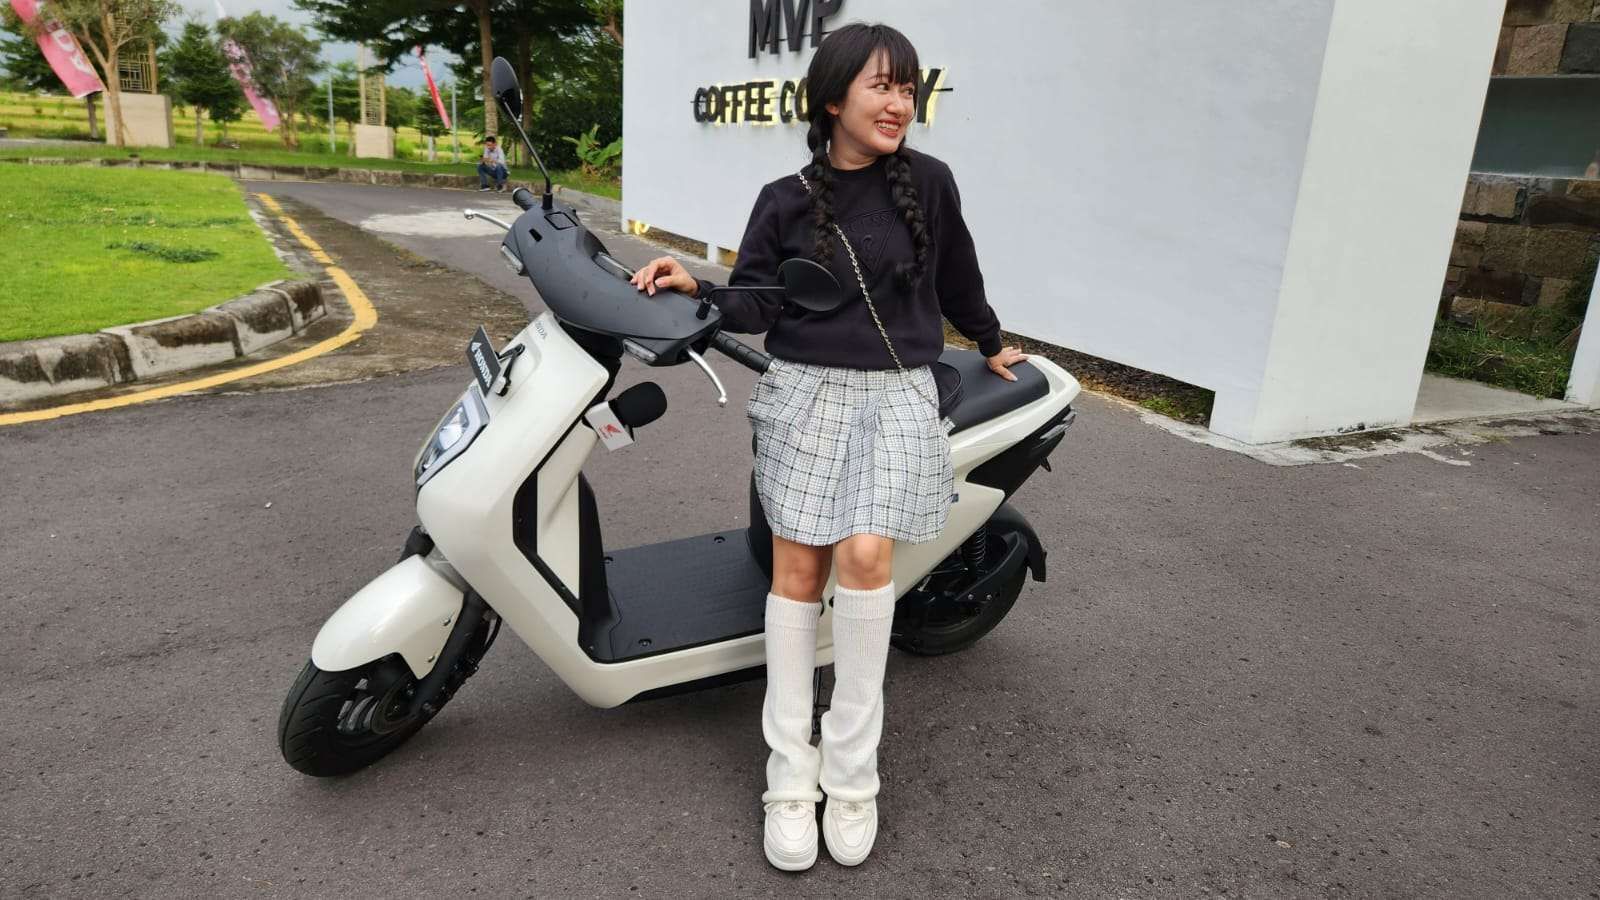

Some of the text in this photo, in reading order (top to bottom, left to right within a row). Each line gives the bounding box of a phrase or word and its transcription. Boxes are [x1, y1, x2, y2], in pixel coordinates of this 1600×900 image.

[748, 0, 844, 58] MVP
[693, 81, 774, 123] COFFEE
[474, 348, 493, 388] HONDA
